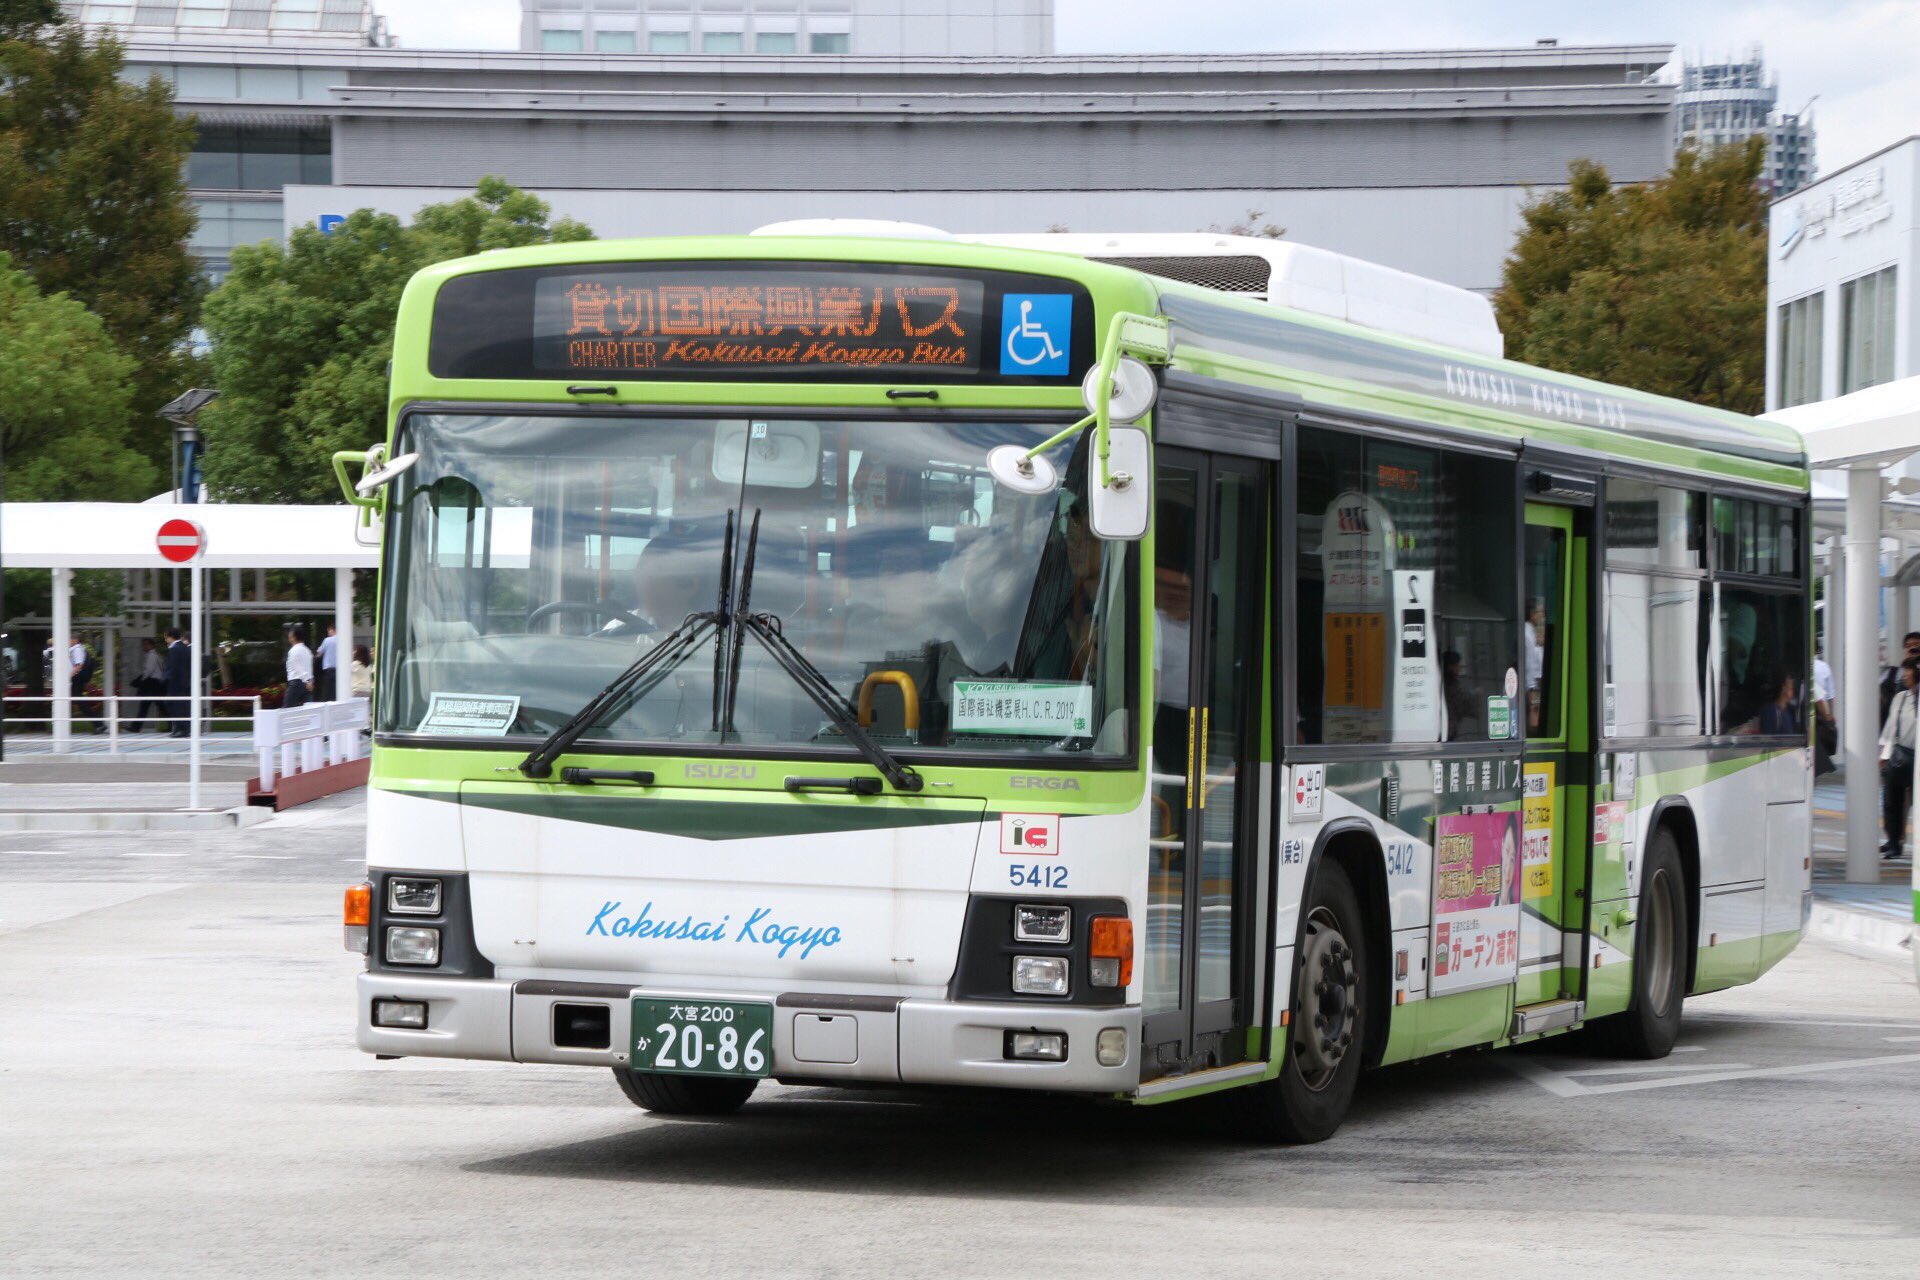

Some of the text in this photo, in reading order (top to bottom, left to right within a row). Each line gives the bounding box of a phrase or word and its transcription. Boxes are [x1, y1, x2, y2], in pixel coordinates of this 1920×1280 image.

[565, 283, 965, 337] 貸切国際興業バス
[569, 340, 966, 368] CHARTER Kokusai Kogyo Bus
[1444, 364, 1517, 407] KOKUSAI
[1530, 383, 1584, 421] KOGYO
[1074, 717, 1086, 731] 様
[684, 763, 757, 779] ISUZU
[1009, 775, 1082, 791] ERGA
[1306, 769, 1321, 792] 出口
[1433, 760, 1521, 794] 国際興業バス
[1306, 795, 1318, 809] EXIT
[1388, 844, 1413, 876] 5412
[1009, 864, 1069, 888] 5412
[586, 901, 842, 961] Kokusai Kogyo
[669, 1005, 734, 1022] 大宮 200
[637, 1023, 765, 1072] か 20-86
